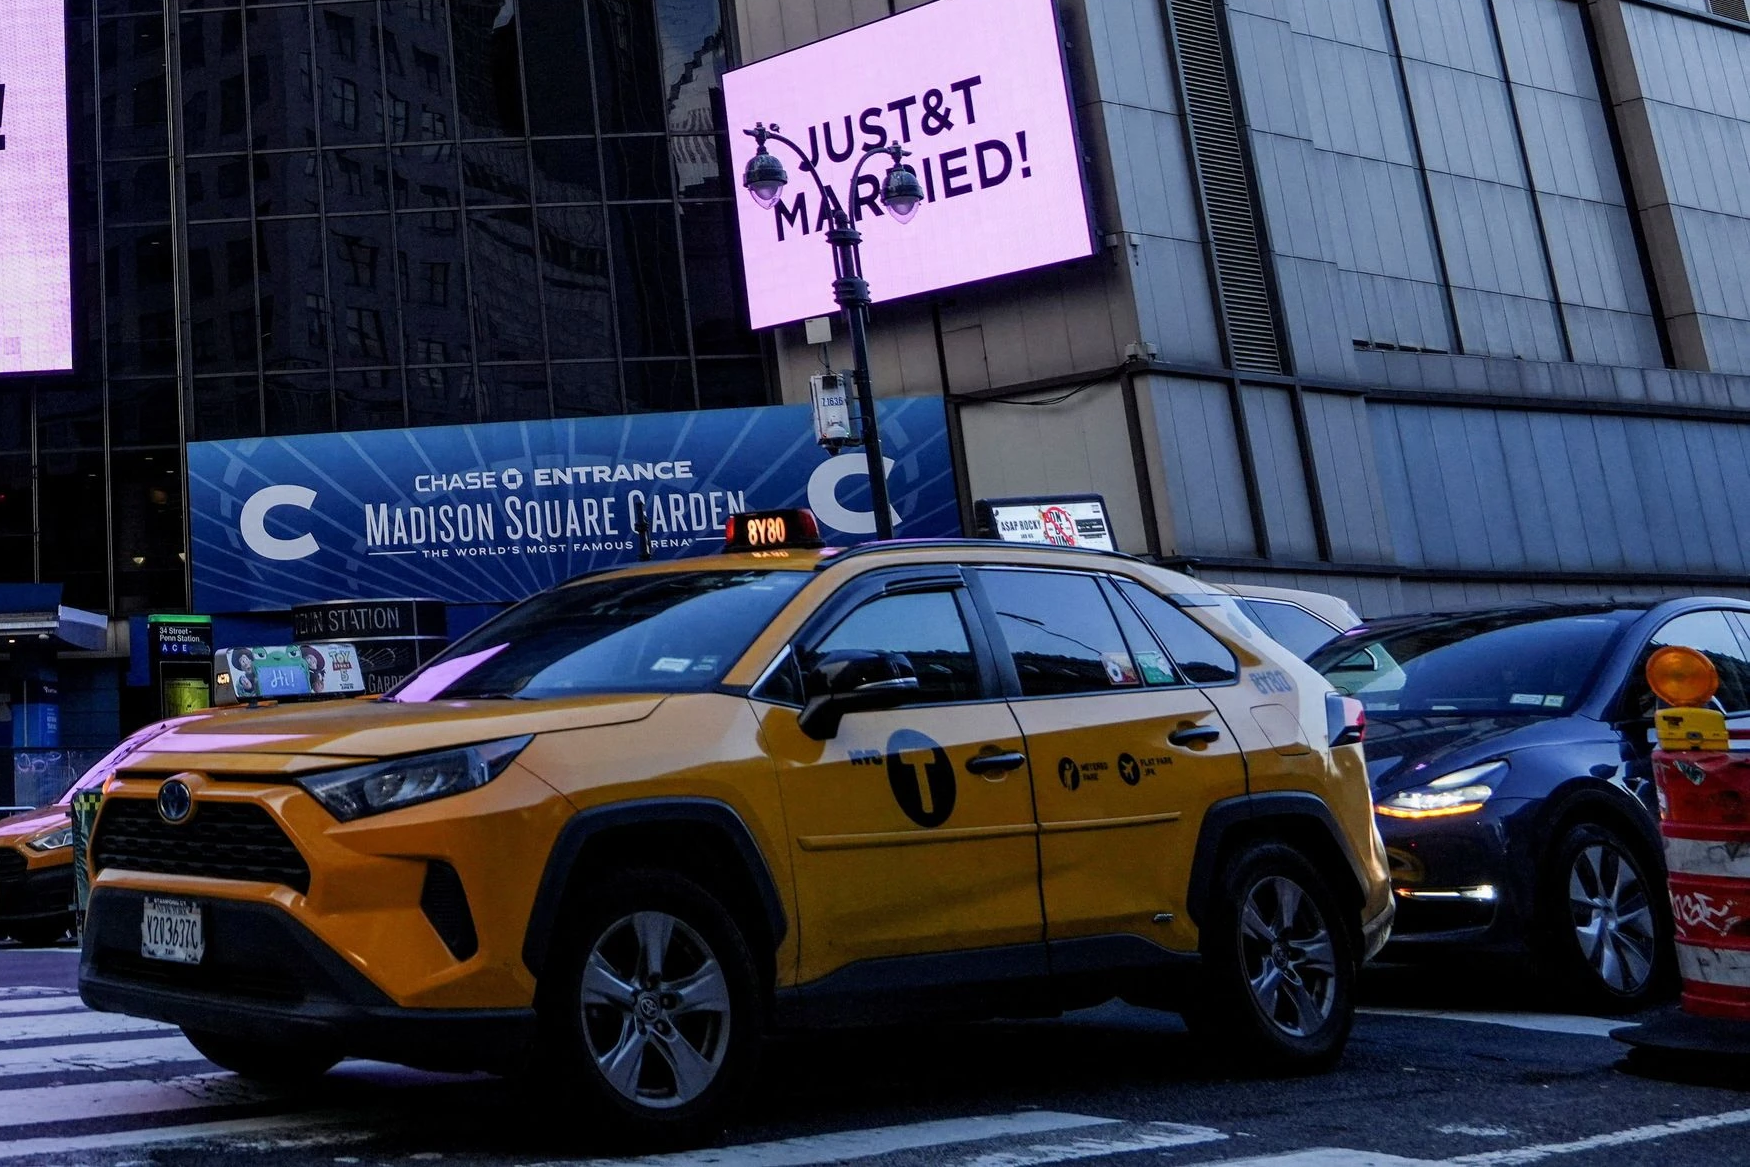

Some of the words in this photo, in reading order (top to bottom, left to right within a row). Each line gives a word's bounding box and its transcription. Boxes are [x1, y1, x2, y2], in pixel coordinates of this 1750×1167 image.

[798, 75, 982, 172] JUST&T
[773, 130, 1032, 242] MARIED!
[414, 471, 498, 493] CHASE
[534, 460, 694, 487] ENTRANCE
[807, 452, 903, 534] C
[240, 484, 321, 561] C
[364, 502, 495, 547] MADISON
[504, 495, 619, 543] SQUARE
[747, 516, 786, 546] 8Y80
[1019, 519, 1042, 531] ROCKY
[421, 548, 449, 558] THE
[455, 545, 521, 557] WORLD'S
[526, 544, 567, 554] MOST
[573, 540, 634, 551] FAMOUS
[159, 626, 168, 634] 34
[168, 627, 188, 635] Street
[328, 607, 400, 632] STATION
[159, 634, 176, 642] Penn
[176, 635, 200, 643] Station
[162, 644, 168, 652] A
[172, 644, 178, 652] C
[182, 644, 187, 652] E
[328, 650, 351, 664] TOY
[270, 667, 296, 690] Hi!
[898, 748, 936, 814] T
[146, 914, 199, 950] Y203637C
